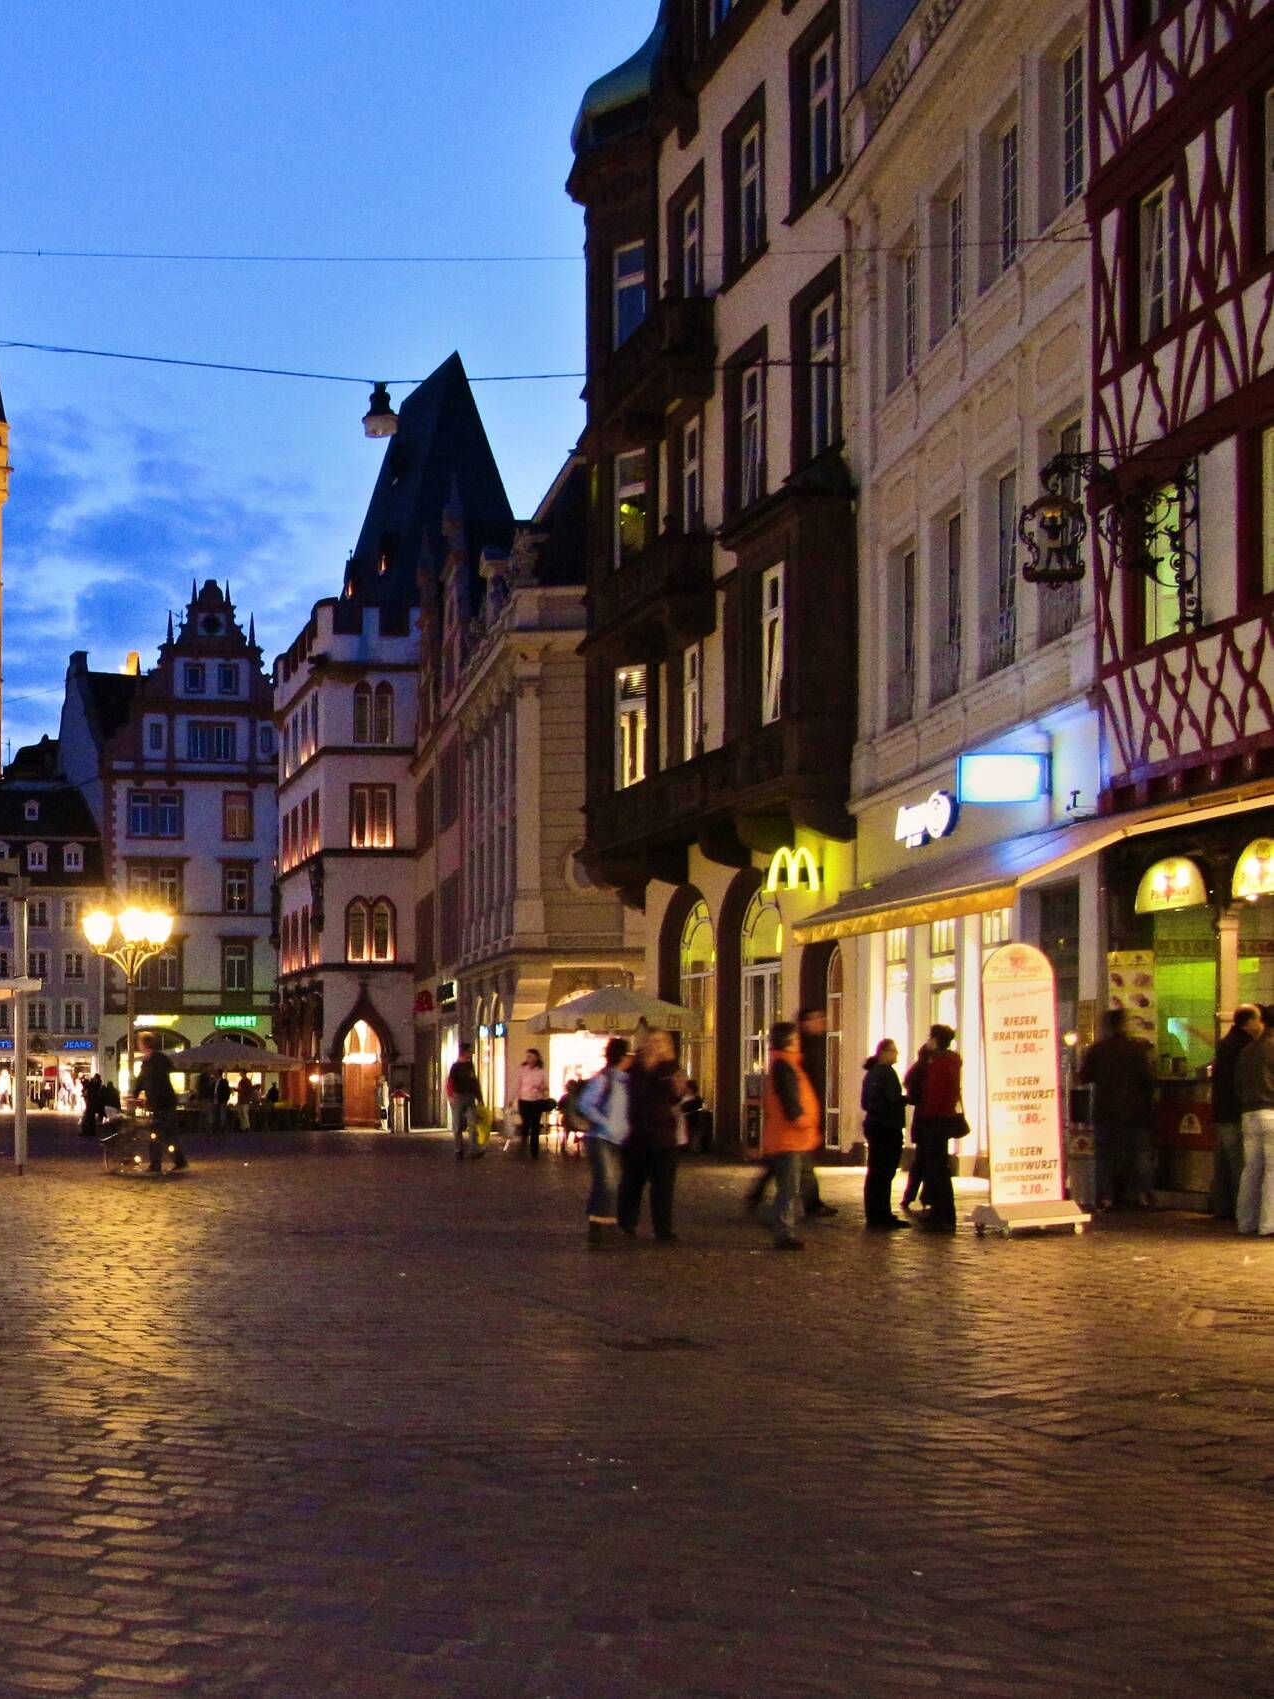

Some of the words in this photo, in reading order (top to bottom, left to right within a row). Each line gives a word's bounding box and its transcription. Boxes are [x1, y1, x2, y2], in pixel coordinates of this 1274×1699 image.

[214, 1015, 258, 1027] LAMBERT
[1003, 1016, 1037, 1026] RIESEN
[992, 1029, 1050, 1040] BRATWURST
[64, 1041, 92, 1049] JEANS
[1006, 1076, 1040, 1086] RIESEN
[991, 1089, 1055, 1101] CURRYWURST
[1009, 1147, 1043, 1157] RIESEN
[994, 1160, 1058, 1172] CURRYWURST
